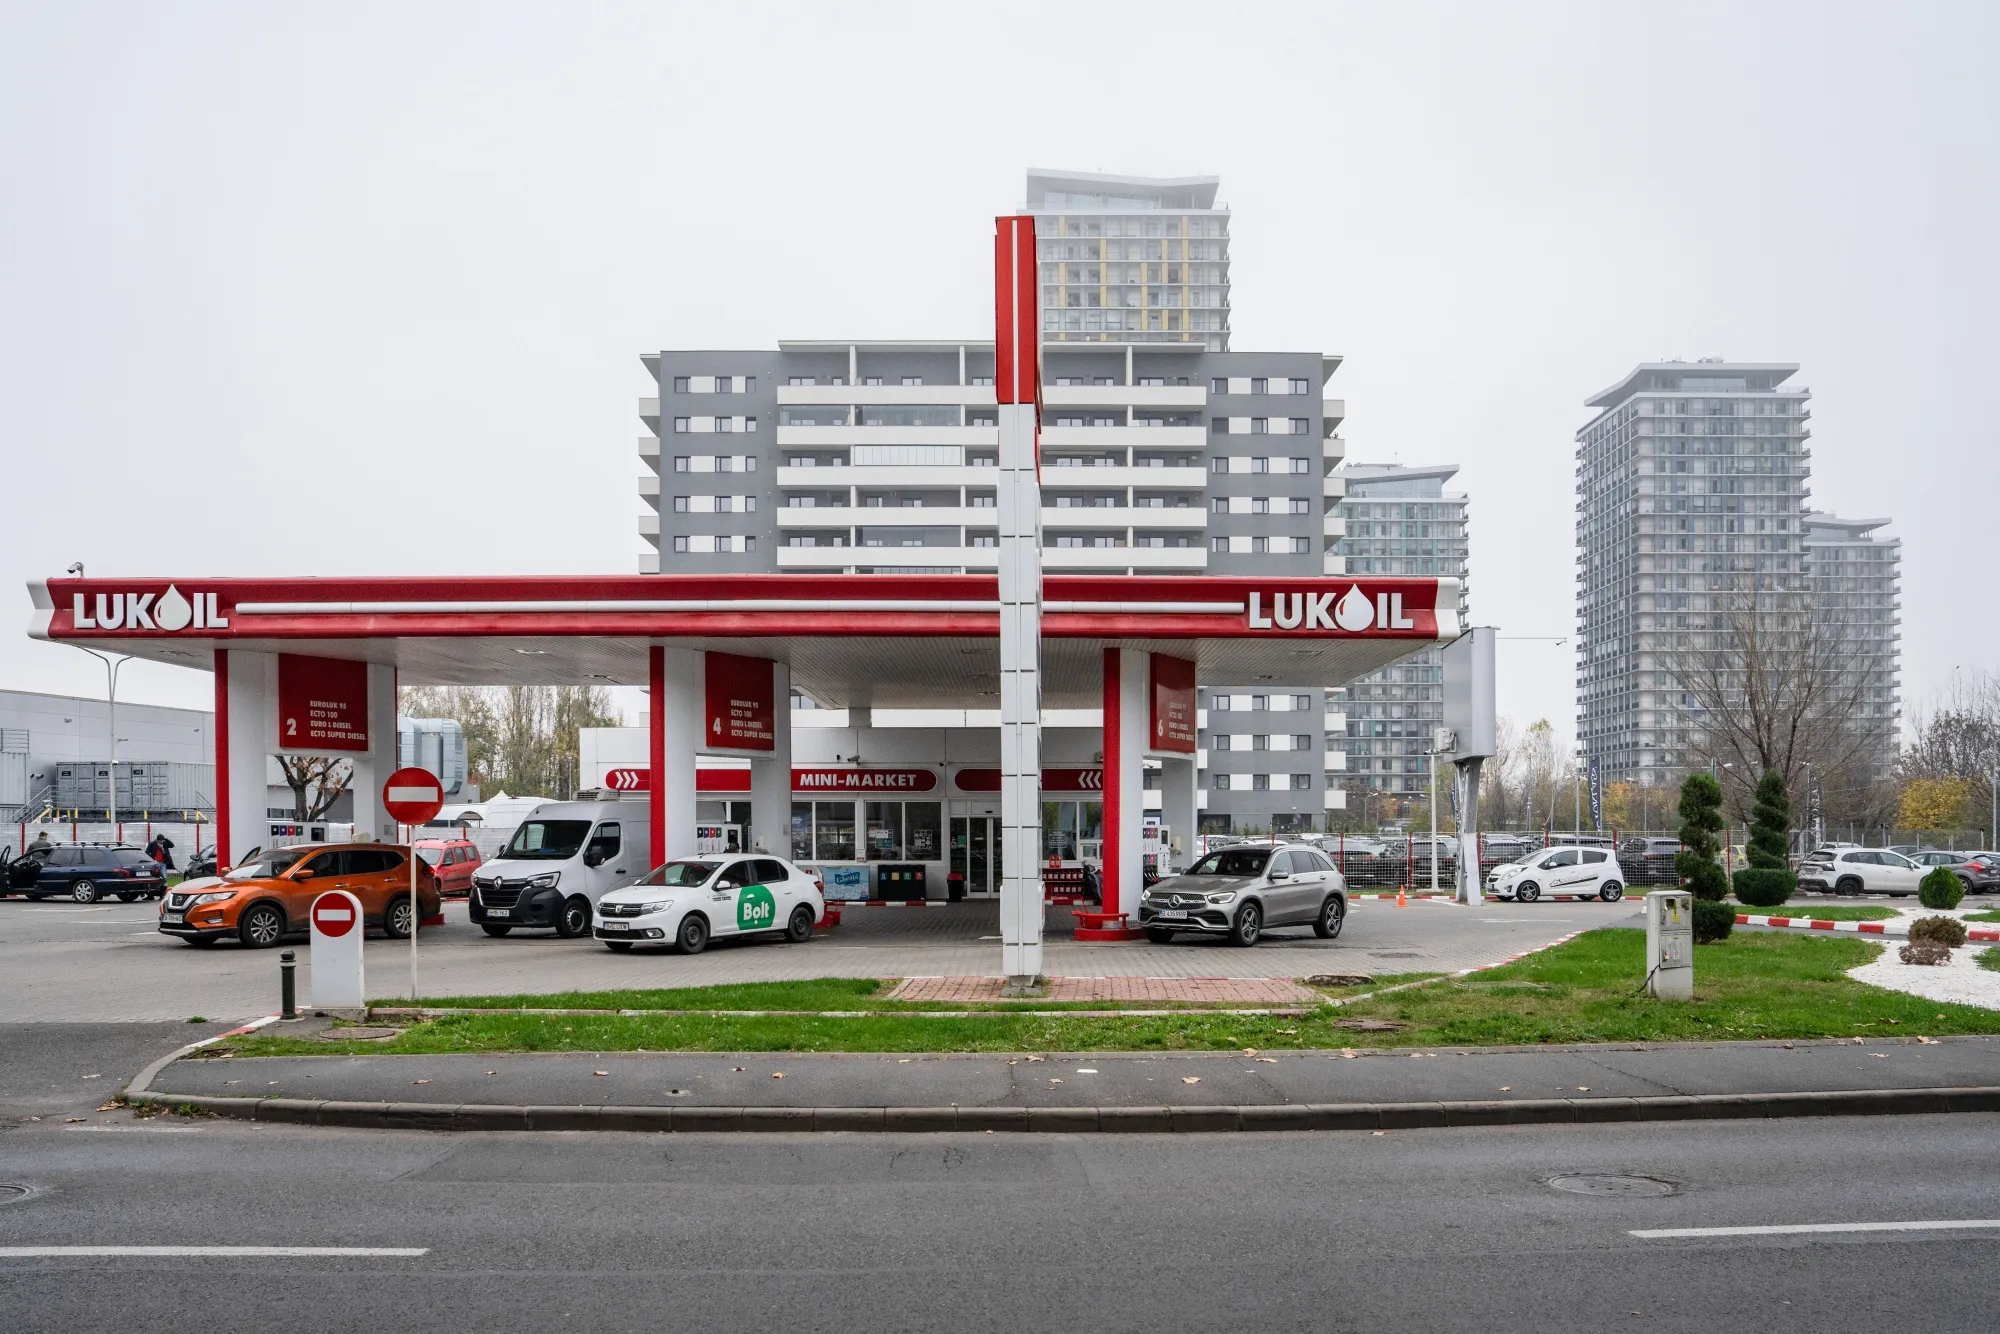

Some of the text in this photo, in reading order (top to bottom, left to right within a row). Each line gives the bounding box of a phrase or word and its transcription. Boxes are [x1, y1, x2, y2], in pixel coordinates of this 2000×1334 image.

[74, 583, 229, 631] LUKOIL
[1249, 582, 1414, 632] LUKOIL
[310, 700, 347, 710] EUROLUK 95
[310, 710, 338, 719] ECTO 100
[731, 709, 743, 717] ECTO
[286, 718, 297, 736] 2
[310, 720, 327, 728] EURO
[333, 722, 352, 730] DIESEL
[713, 717, 722, 735] 4
[731, 719, 744, 727] EURO
[1158, 719, 1164, 737] 6
[310, 730, 366, 741] ECTO SUPER DIESEL
[731, 729, 773, 740] ECTO SUPER DIESEL
[800, 773, 917, 787] MINI-MARKET
[743, 901, 770, 924] Bolt
